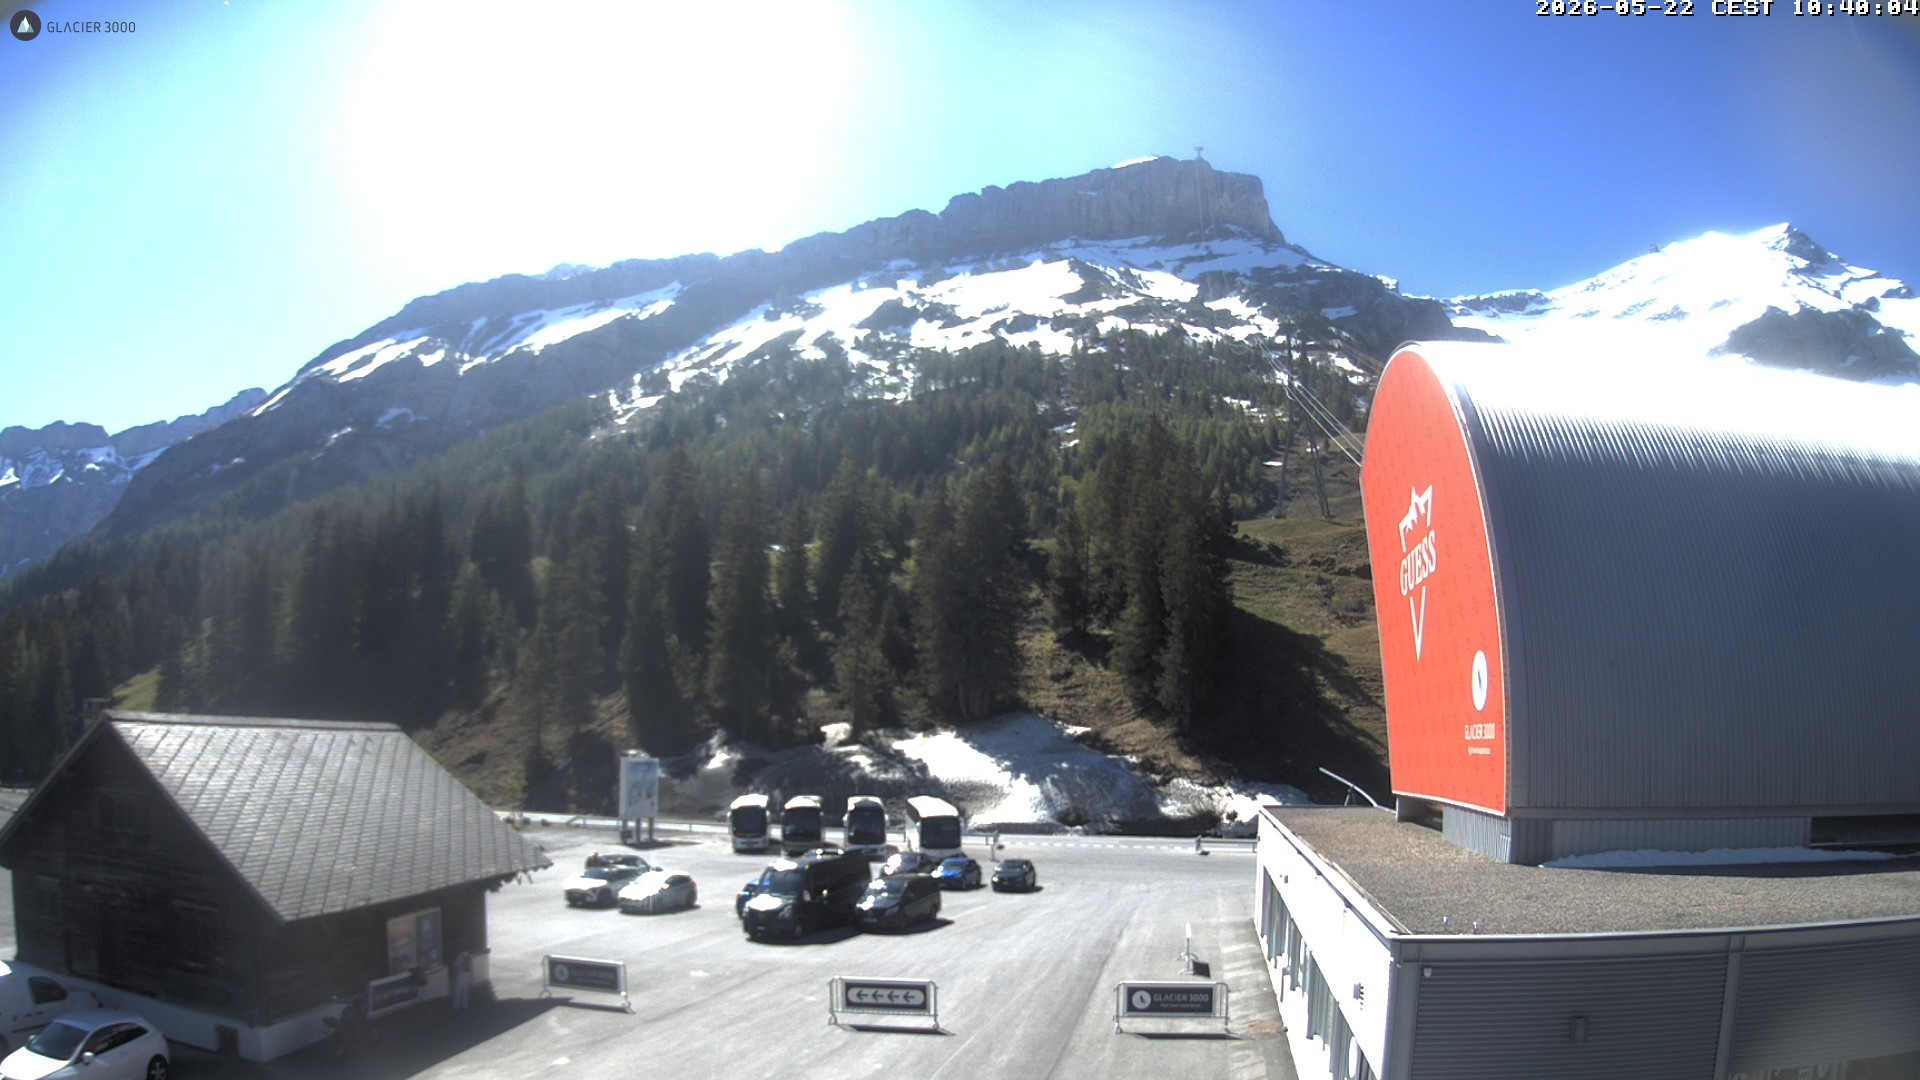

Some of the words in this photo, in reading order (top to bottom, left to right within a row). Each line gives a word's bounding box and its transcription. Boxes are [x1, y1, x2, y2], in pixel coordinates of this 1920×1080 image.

[1400, 529, 1437, 597] GUESS
[1153, 993, 1188, 1002] GLACIER
[1189, 993, 1209, 1003] 3000
